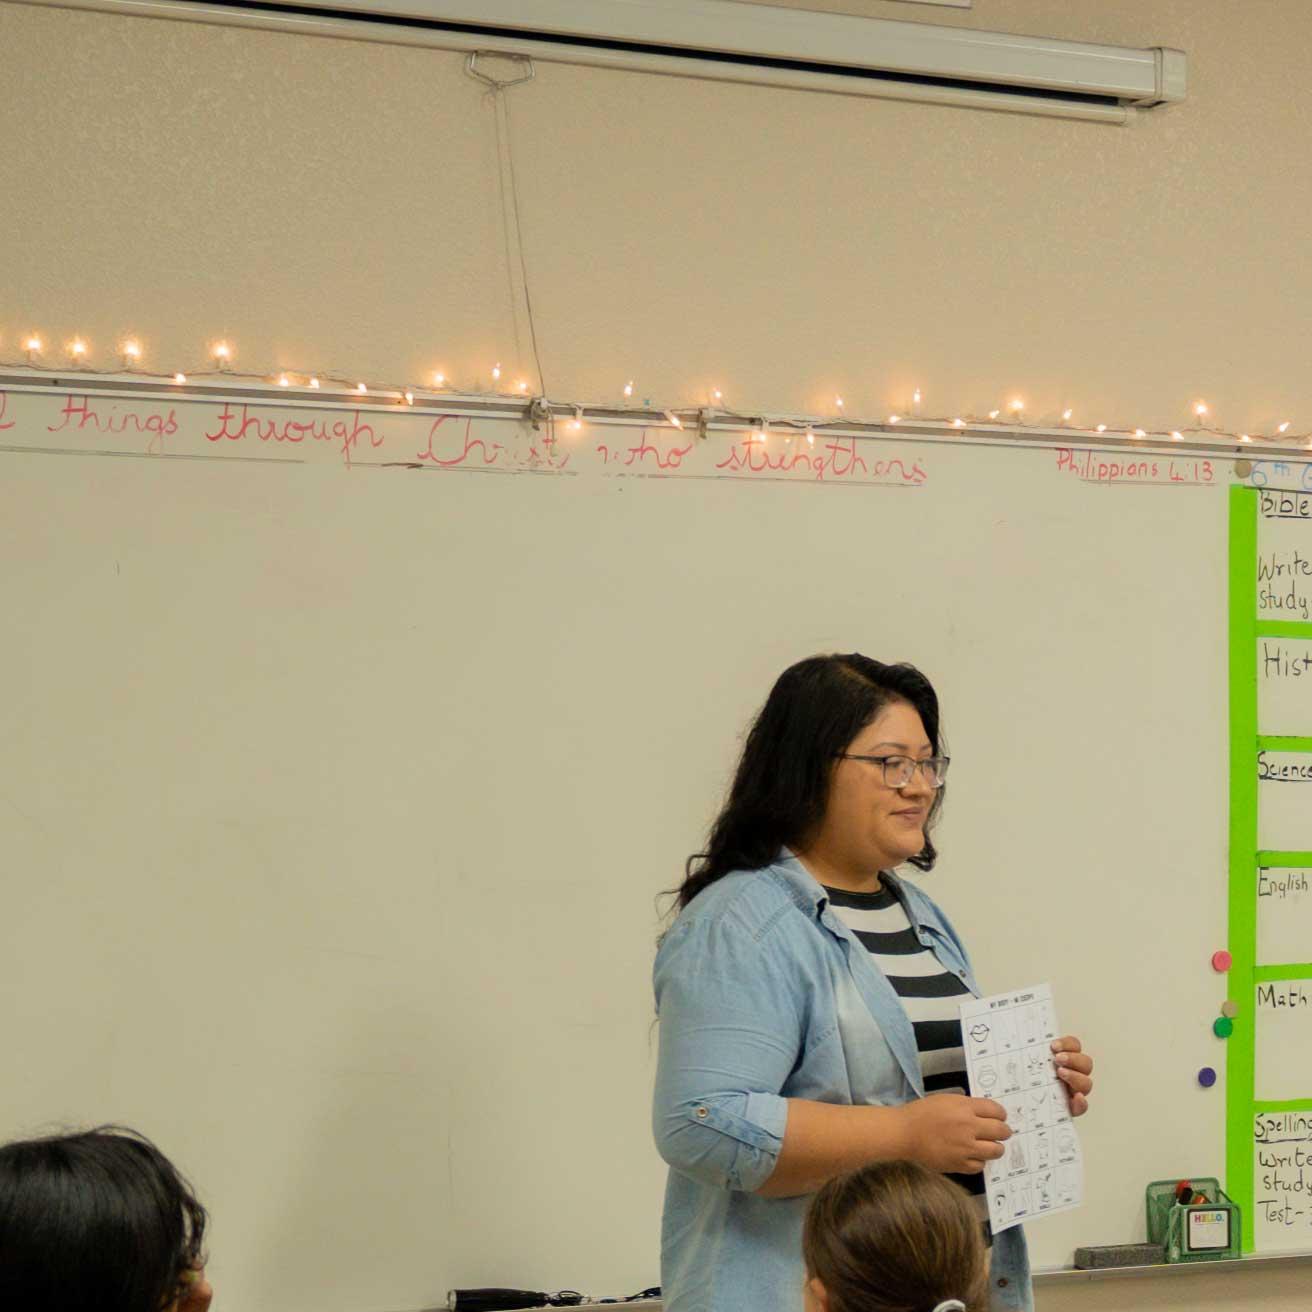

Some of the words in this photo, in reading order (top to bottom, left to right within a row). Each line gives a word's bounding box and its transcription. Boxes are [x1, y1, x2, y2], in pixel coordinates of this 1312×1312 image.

[205, 402, 383, 468] through
[1055, 448, 1159, 484] Philippians
[1169, 461, 1214, 482] 4:13
[1258, 551, 1312, 582] Write
[1257, 984, 1308, 1009] Math
